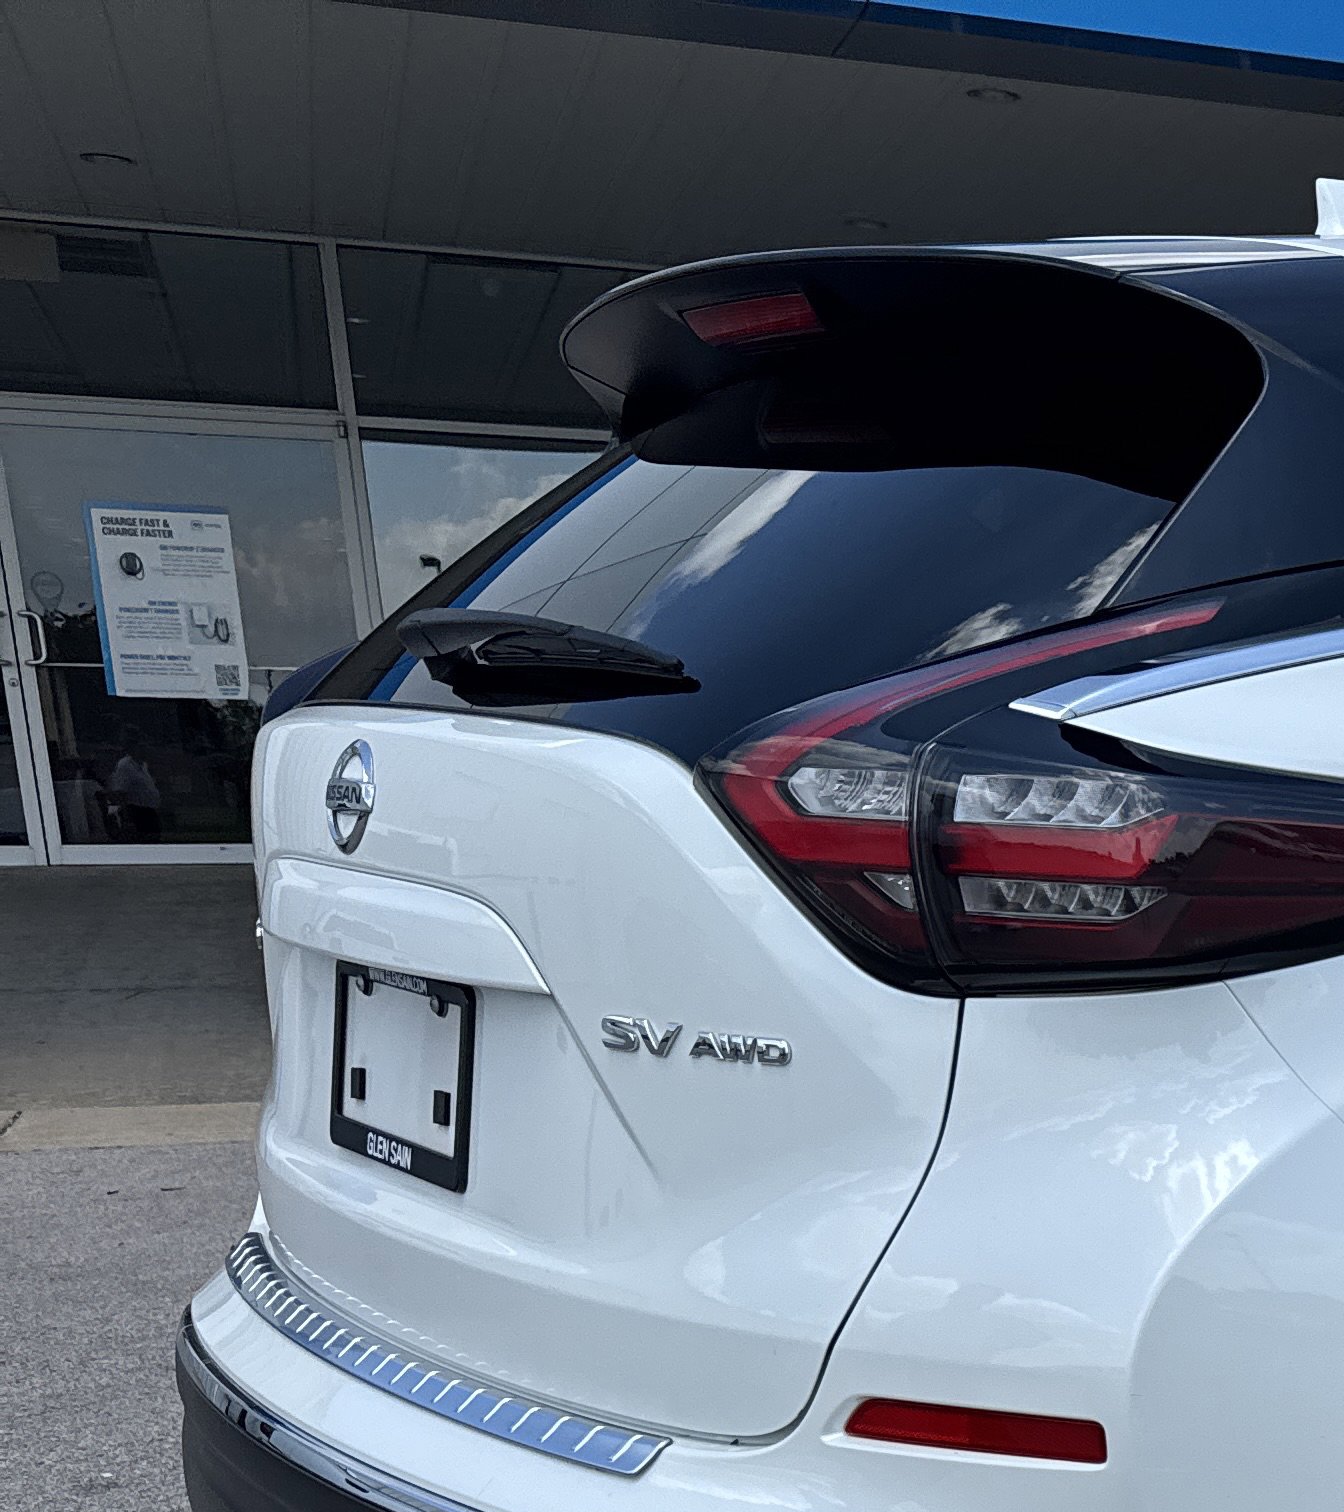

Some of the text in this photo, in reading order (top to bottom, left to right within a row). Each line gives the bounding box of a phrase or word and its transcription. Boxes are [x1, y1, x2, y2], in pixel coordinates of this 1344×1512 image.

[100, 516, 170, 528] CHARGE FAST &
[102, 527, 174, 539] CHARGE FASTER
[601, 1014, 793, 1066] SV AWD
[366, 1132, 412, 1171] GLEN SAIN
